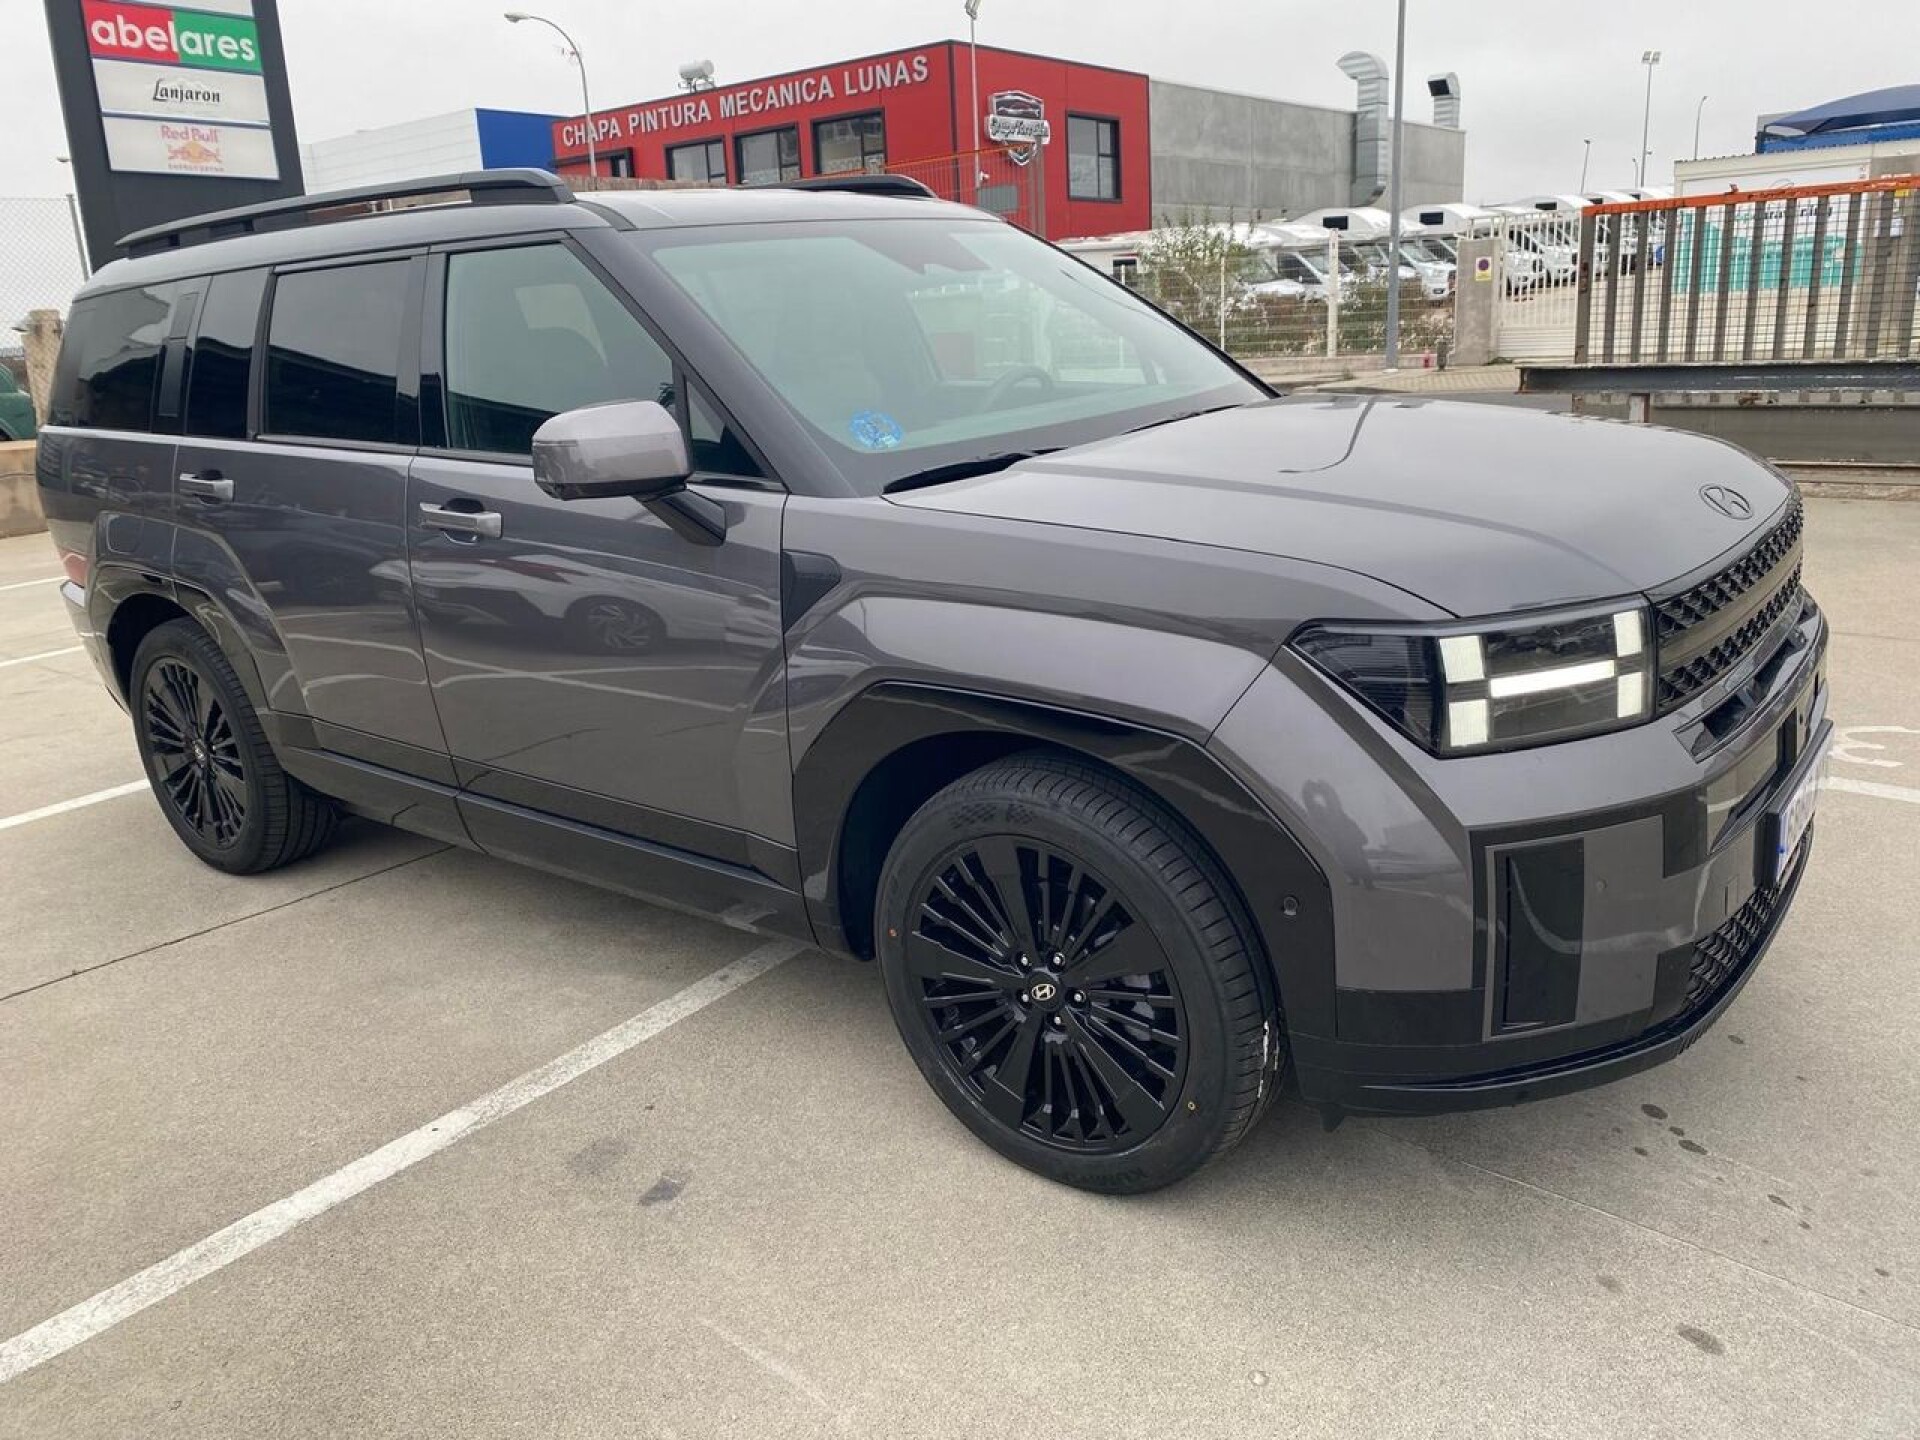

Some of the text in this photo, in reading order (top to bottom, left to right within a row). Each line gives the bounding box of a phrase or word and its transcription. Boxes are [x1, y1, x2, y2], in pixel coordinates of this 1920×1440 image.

[91, 15, 256, 61] abelares
[563, 56, 928, 147] CHAPA PINTURA MECANICA LUNAS
[161, 125, 218, 143] Red Bull
